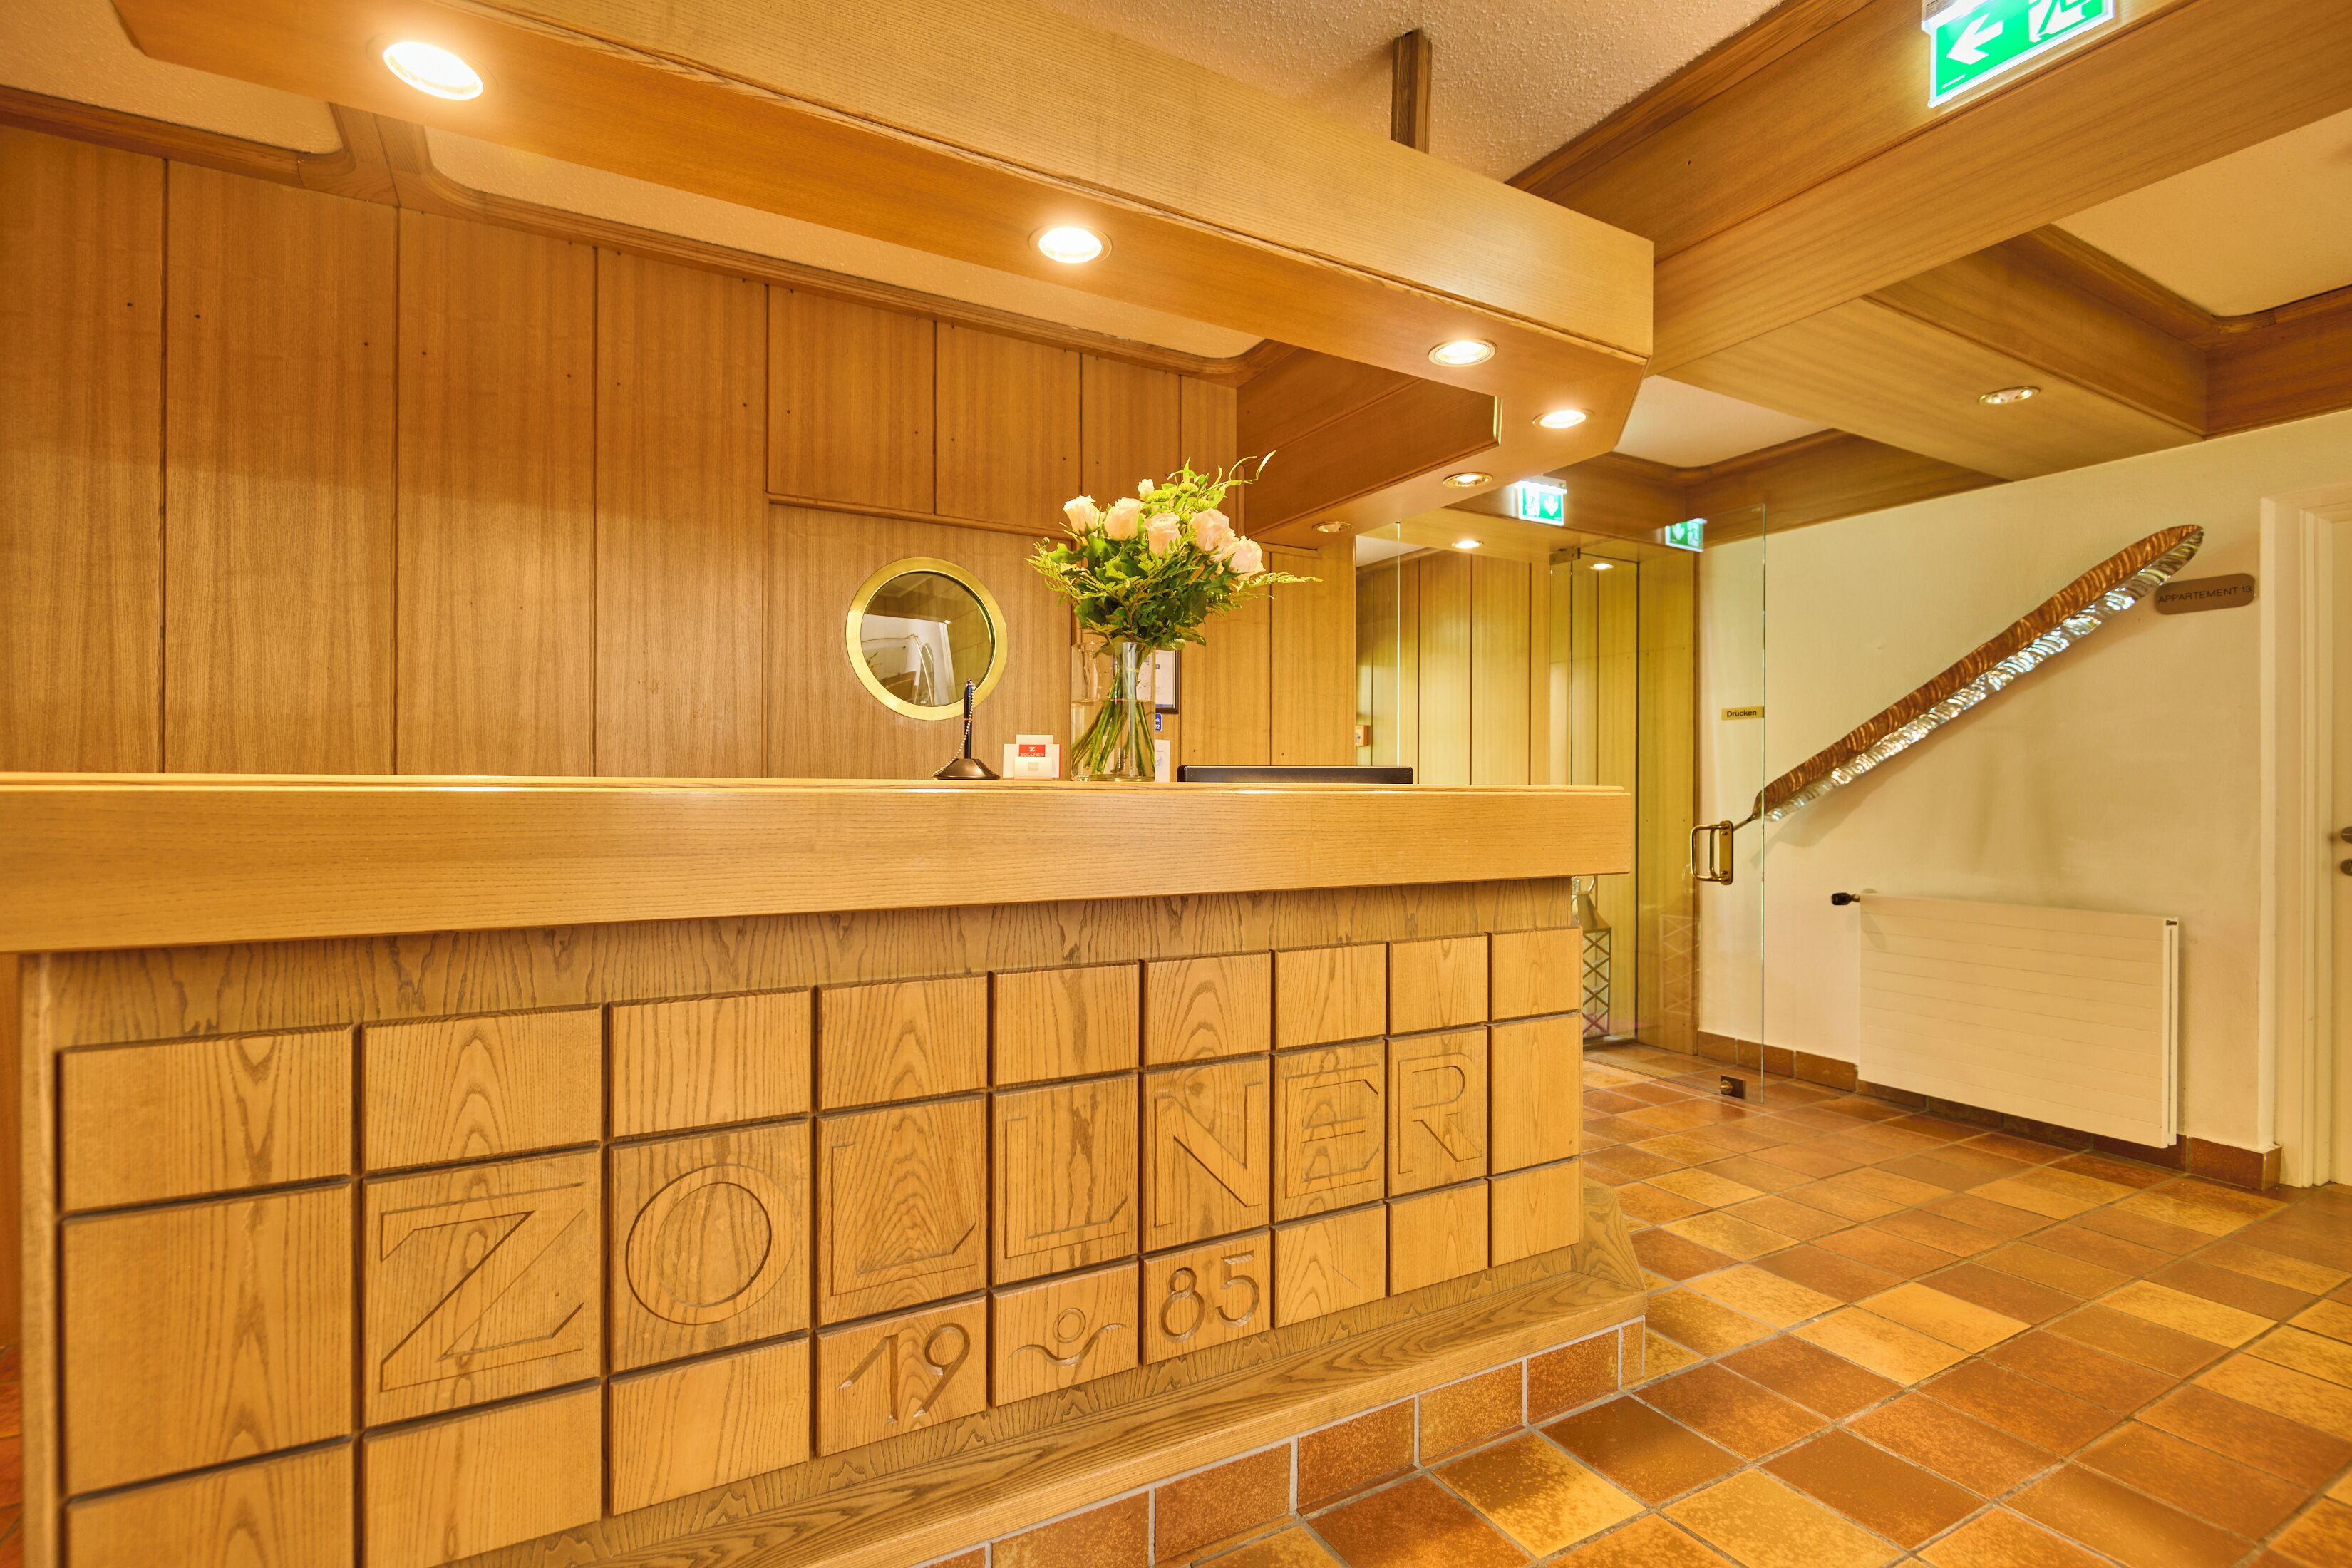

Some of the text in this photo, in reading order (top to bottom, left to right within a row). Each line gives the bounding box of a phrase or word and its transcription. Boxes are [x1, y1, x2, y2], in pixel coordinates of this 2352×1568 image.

[2157, 587, 2239, 604] APPARTEMENT
[380, 1052, 1482, 1393] ZOLLNER
[837, 1250, 1260, 1425] 19 85
